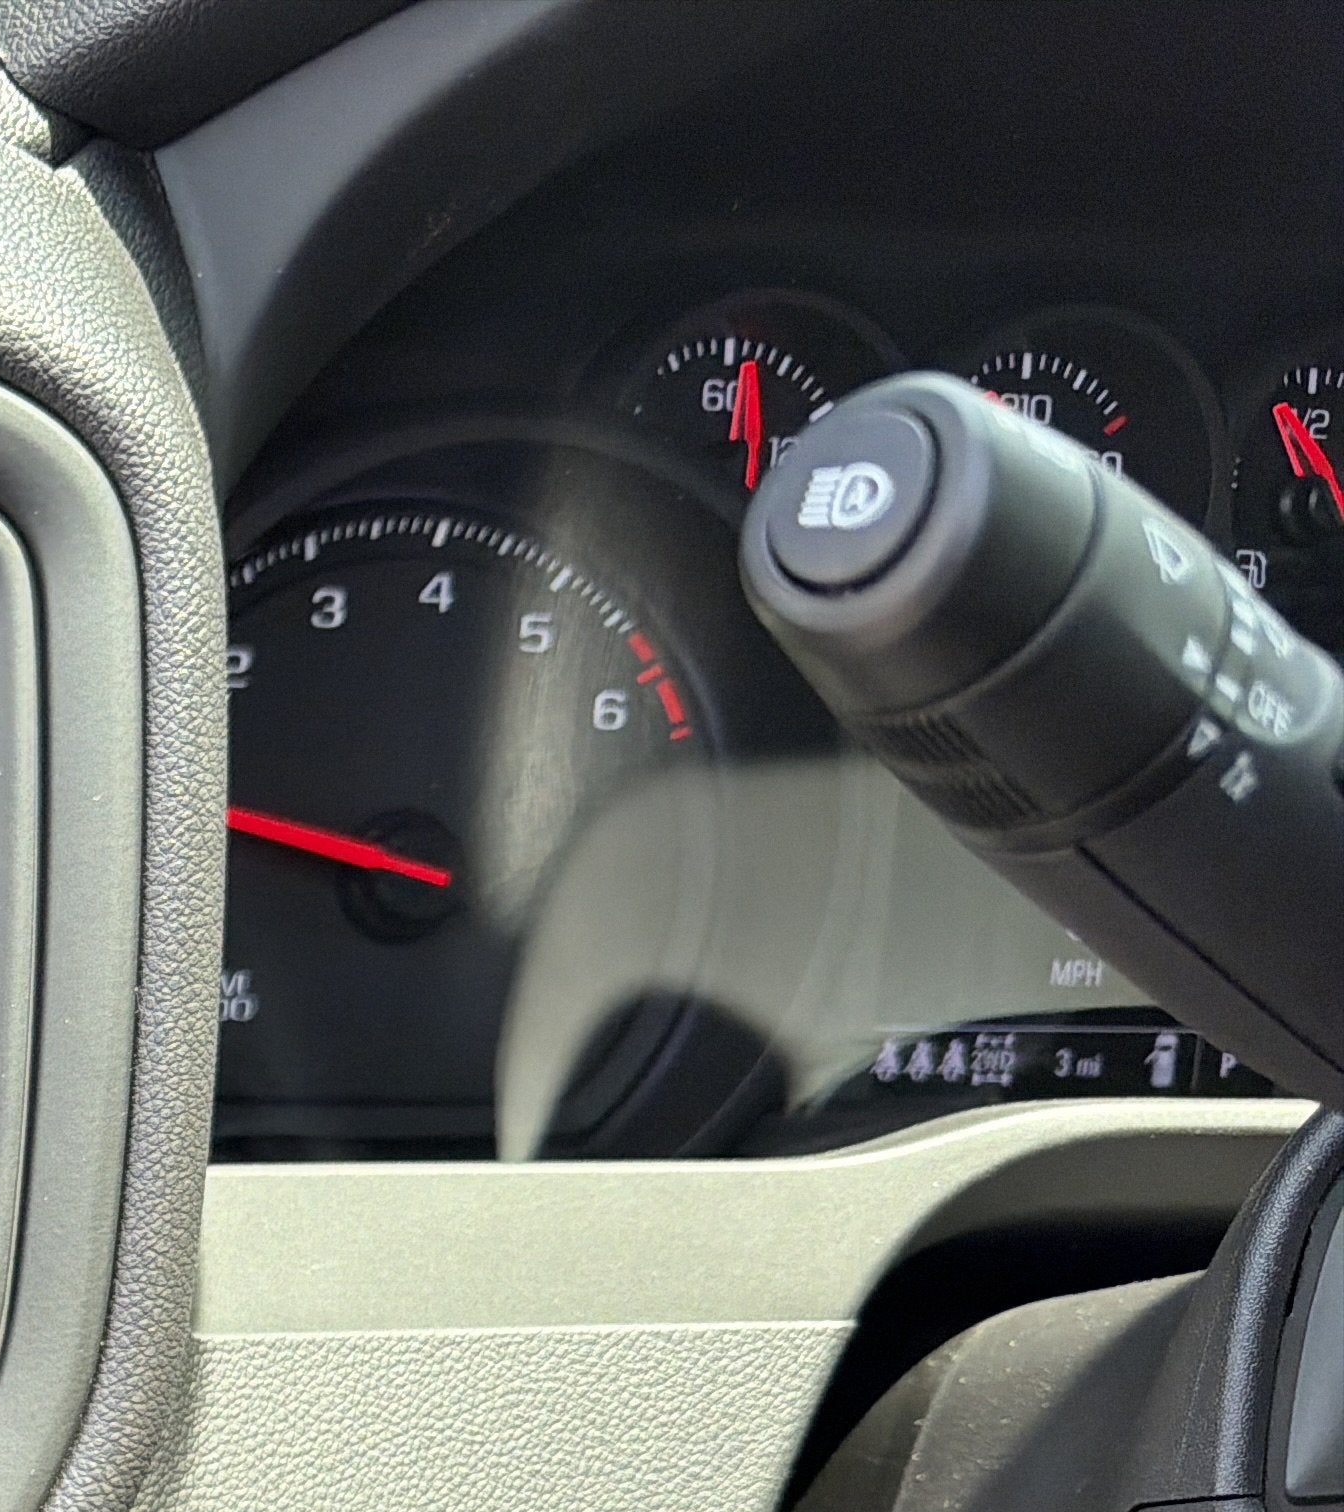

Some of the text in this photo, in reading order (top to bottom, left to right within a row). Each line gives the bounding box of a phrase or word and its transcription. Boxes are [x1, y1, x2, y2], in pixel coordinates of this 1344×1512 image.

[311, 587, 348, 629] 3
[419, 571, 455, 613] 4
[519, 613, 555, 654] 5
[592, 690, 629, 731] 6
[1049, 959, 1103, 988] MPH
[1054, 1048, 1074, 1078] 3
[1218, 1052, 1238, 1079] P
